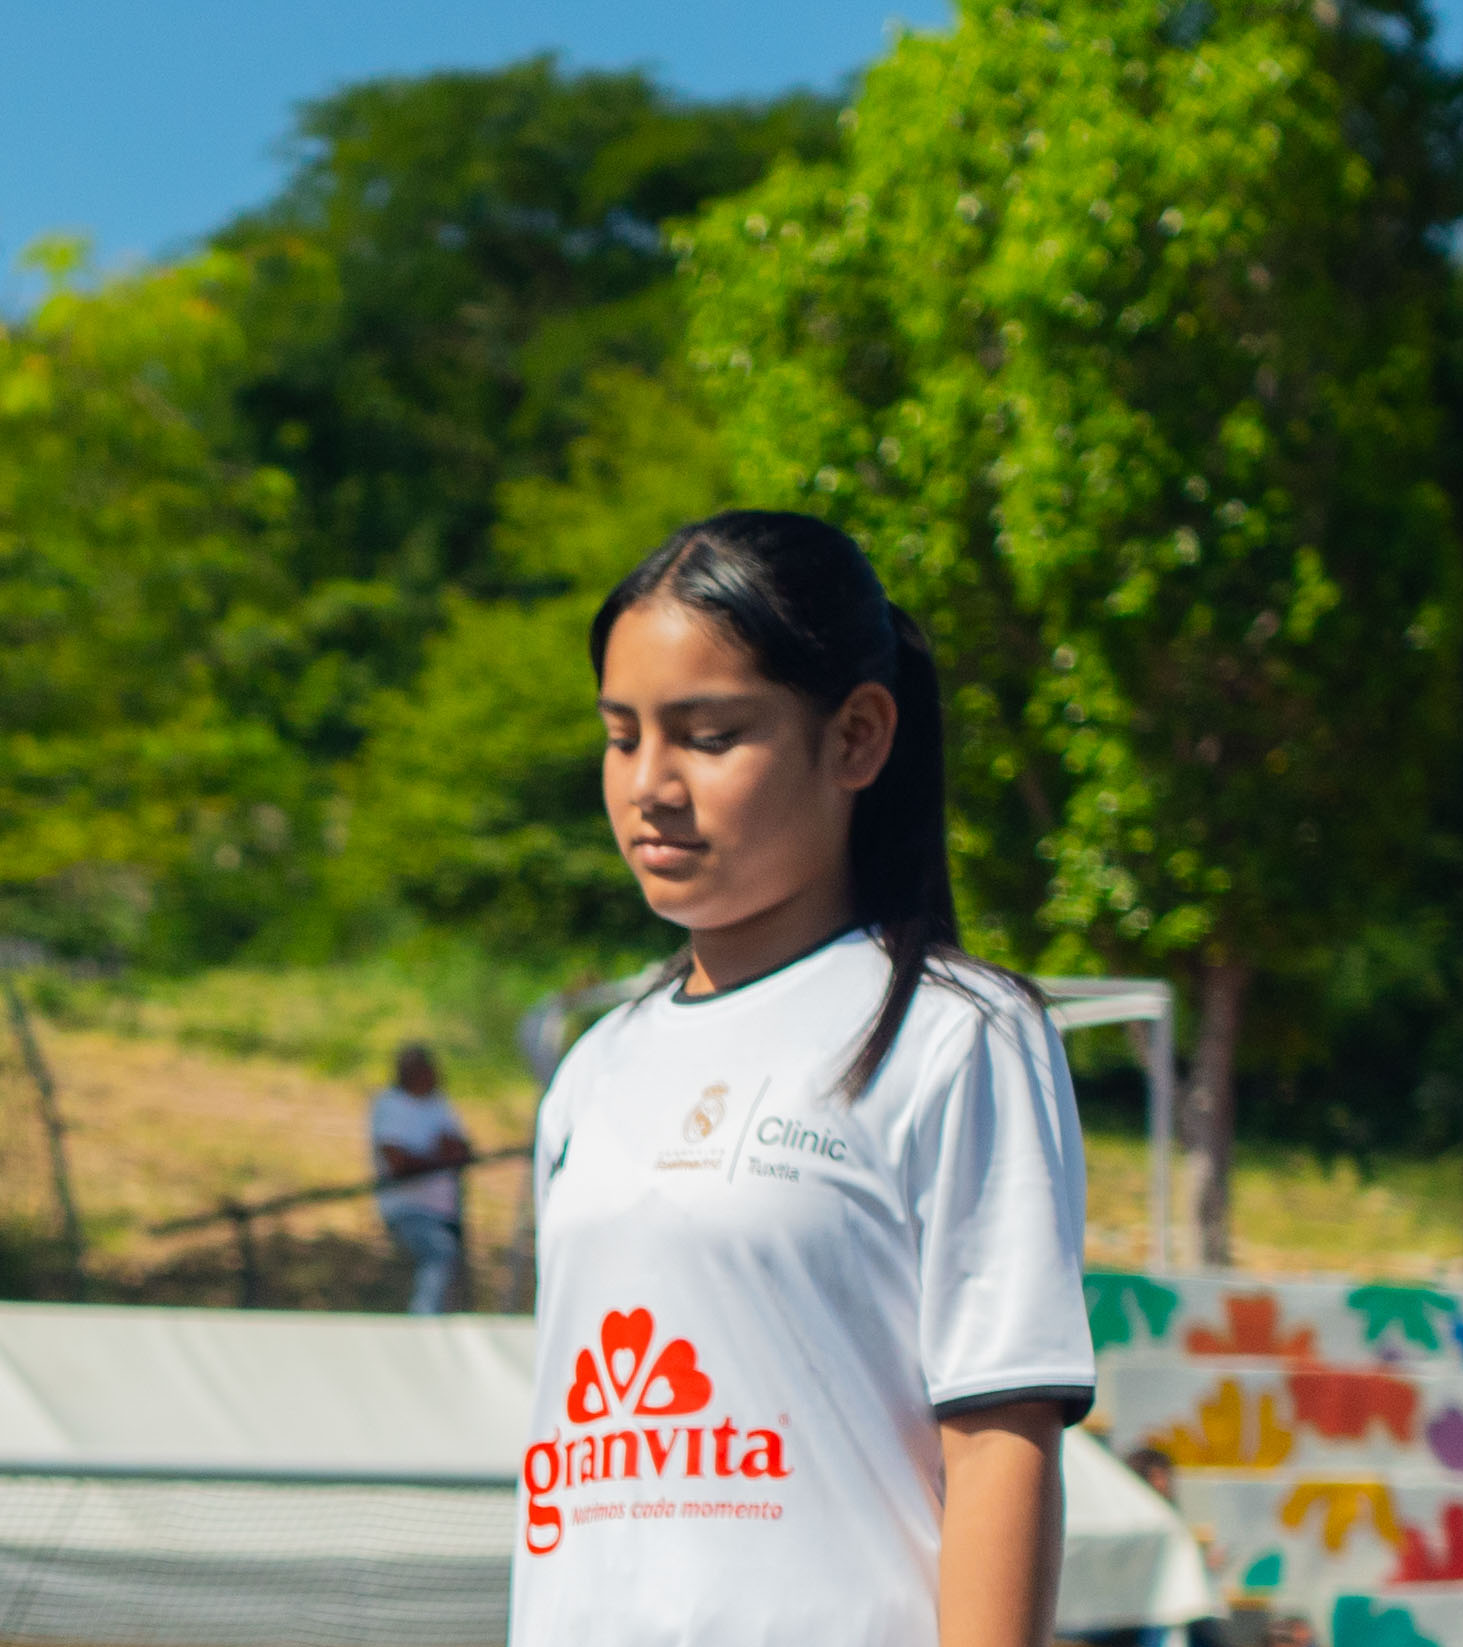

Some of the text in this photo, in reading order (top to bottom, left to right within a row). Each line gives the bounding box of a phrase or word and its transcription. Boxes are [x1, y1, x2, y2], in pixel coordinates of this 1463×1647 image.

[757, 1115, 847, 1162] Clinic
[524, 1414, 795, 1556] granvita
[679, 1500, 784, 1521] momento
